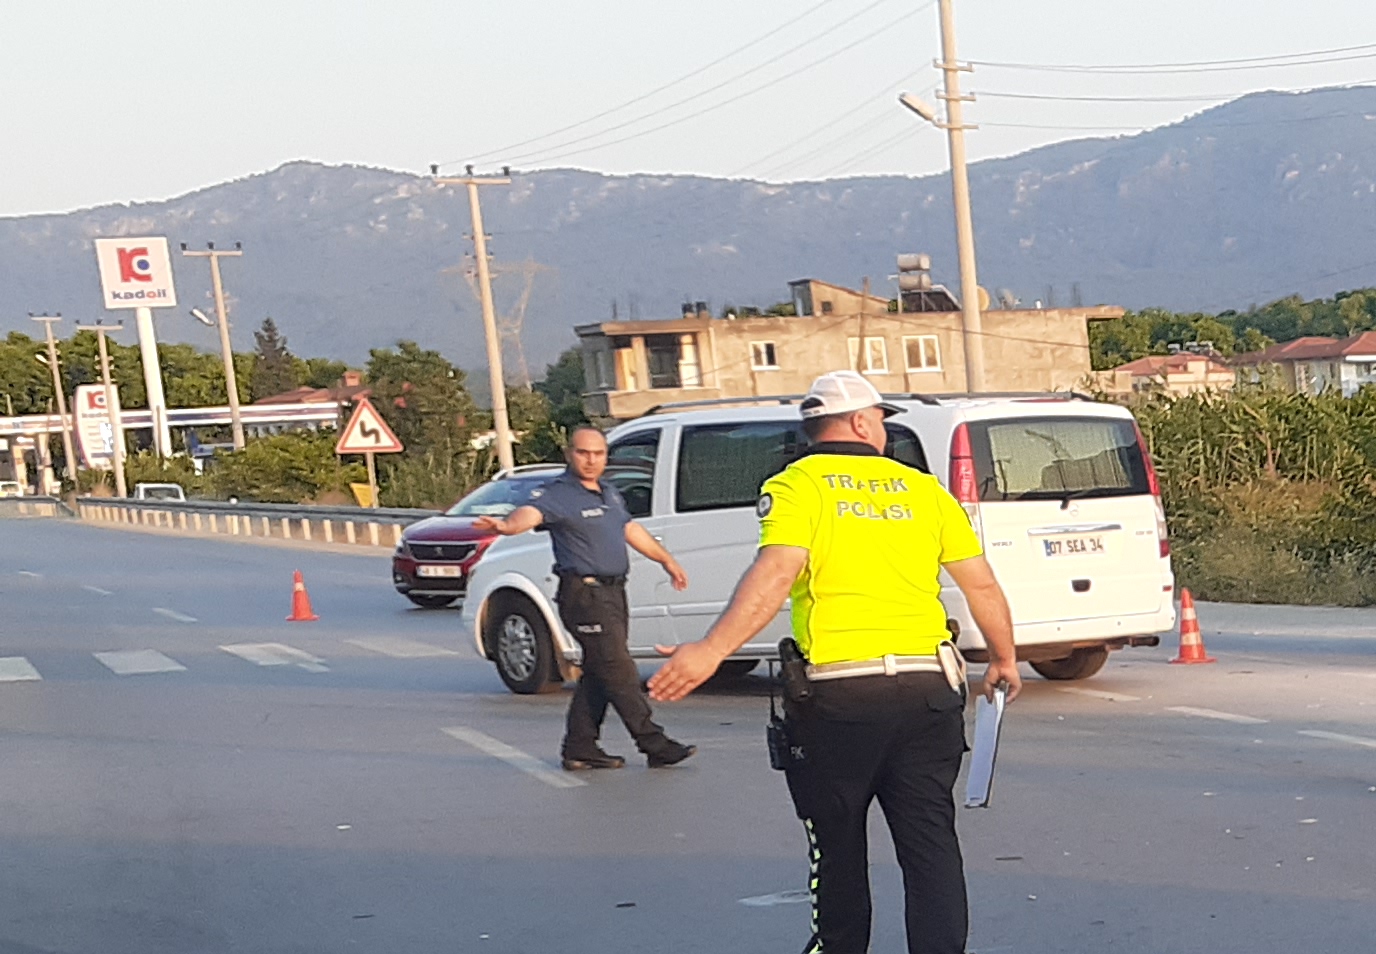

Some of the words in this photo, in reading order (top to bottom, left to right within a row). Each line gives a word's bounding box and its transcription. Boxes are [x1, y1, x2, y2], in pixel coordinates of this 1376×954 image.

[111, 288, 167, 300] kadoil
[1066, 539, 1086, 553] SEA
[1089, 538, 1104, 552] 34
